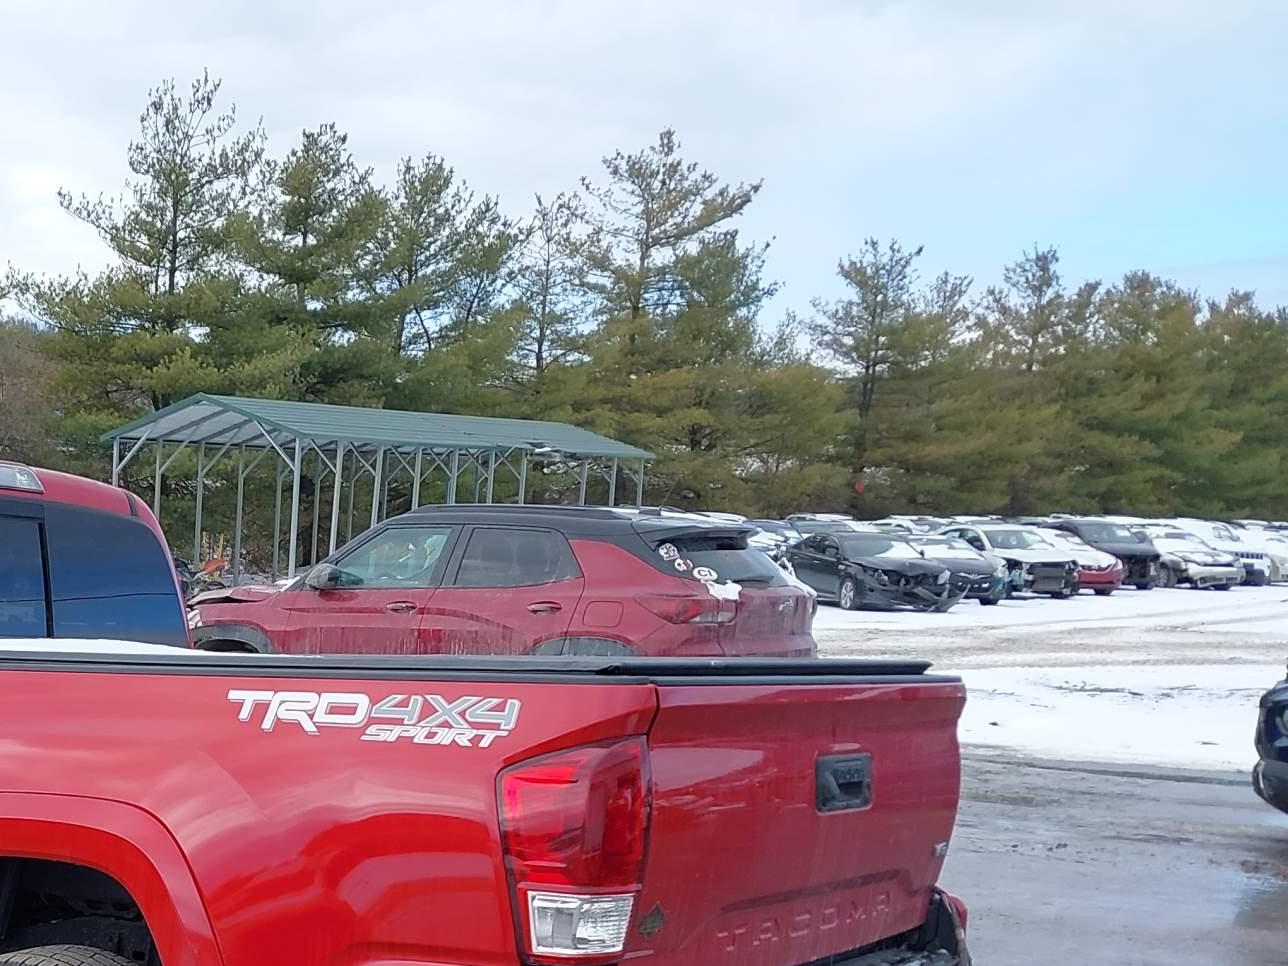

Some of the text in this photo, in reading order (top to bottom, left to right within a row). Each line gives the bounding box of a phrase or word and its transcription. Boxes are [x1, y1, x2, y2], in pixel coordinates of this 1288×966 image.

[227, 690, 371, 735] TRD
[360, 724, 510, 748] SPORT
[716, 891, 891, 951] TACOMA
